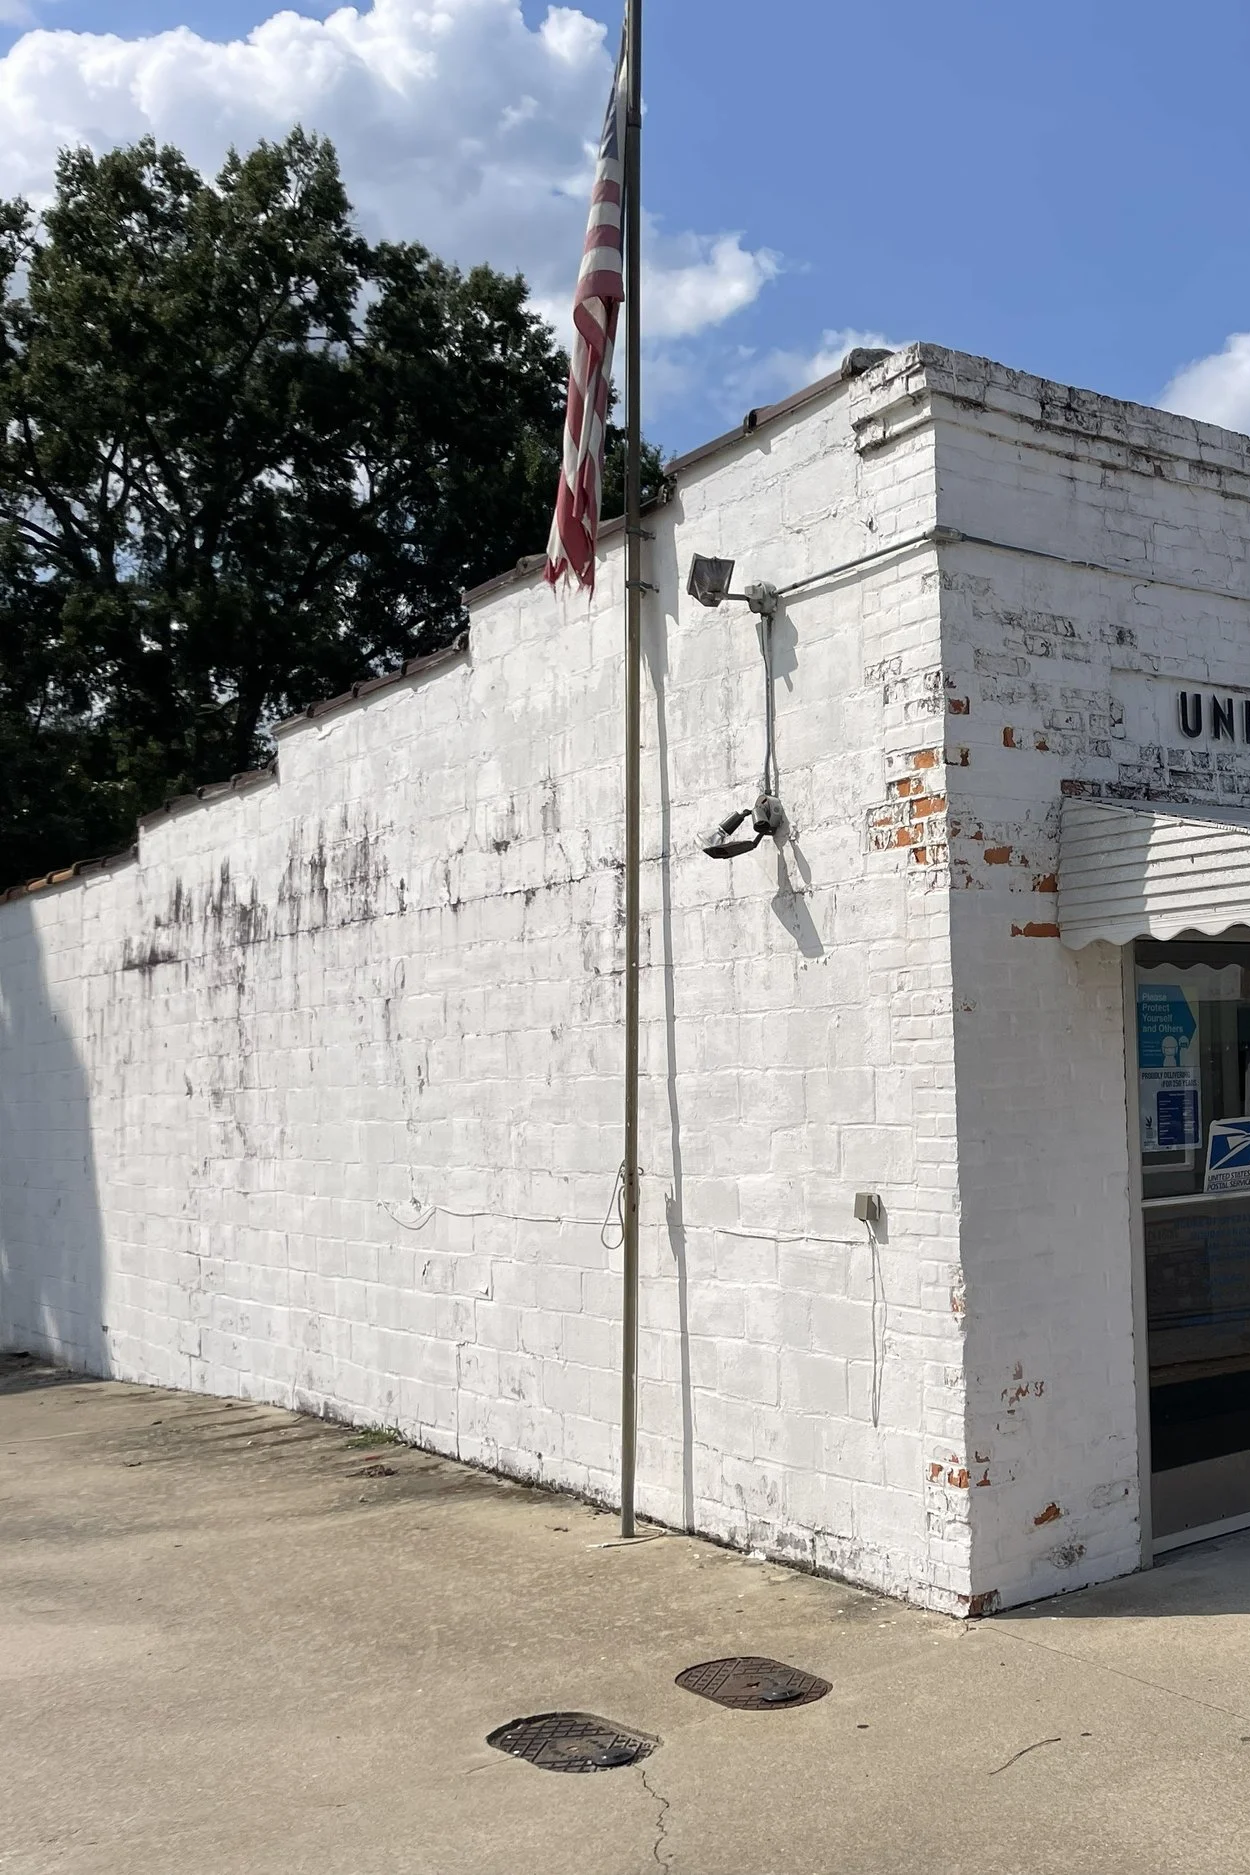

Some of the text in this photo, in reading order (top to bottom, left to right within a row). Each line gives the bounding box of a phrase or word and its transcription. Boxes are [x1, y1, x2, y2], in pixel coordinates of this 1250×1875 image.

[1142, 992, 1168, 1001] Please
[1142, 1003, 1170, 1012] Protect
[1142, 1013, 1173, 1023] Yourself
[1142, 1024, 1184, 1033] and Others
[1208, 1170, 1250, 1182] UNITED STATES
[1207, 1182, 1228, 1191] POSTAL
